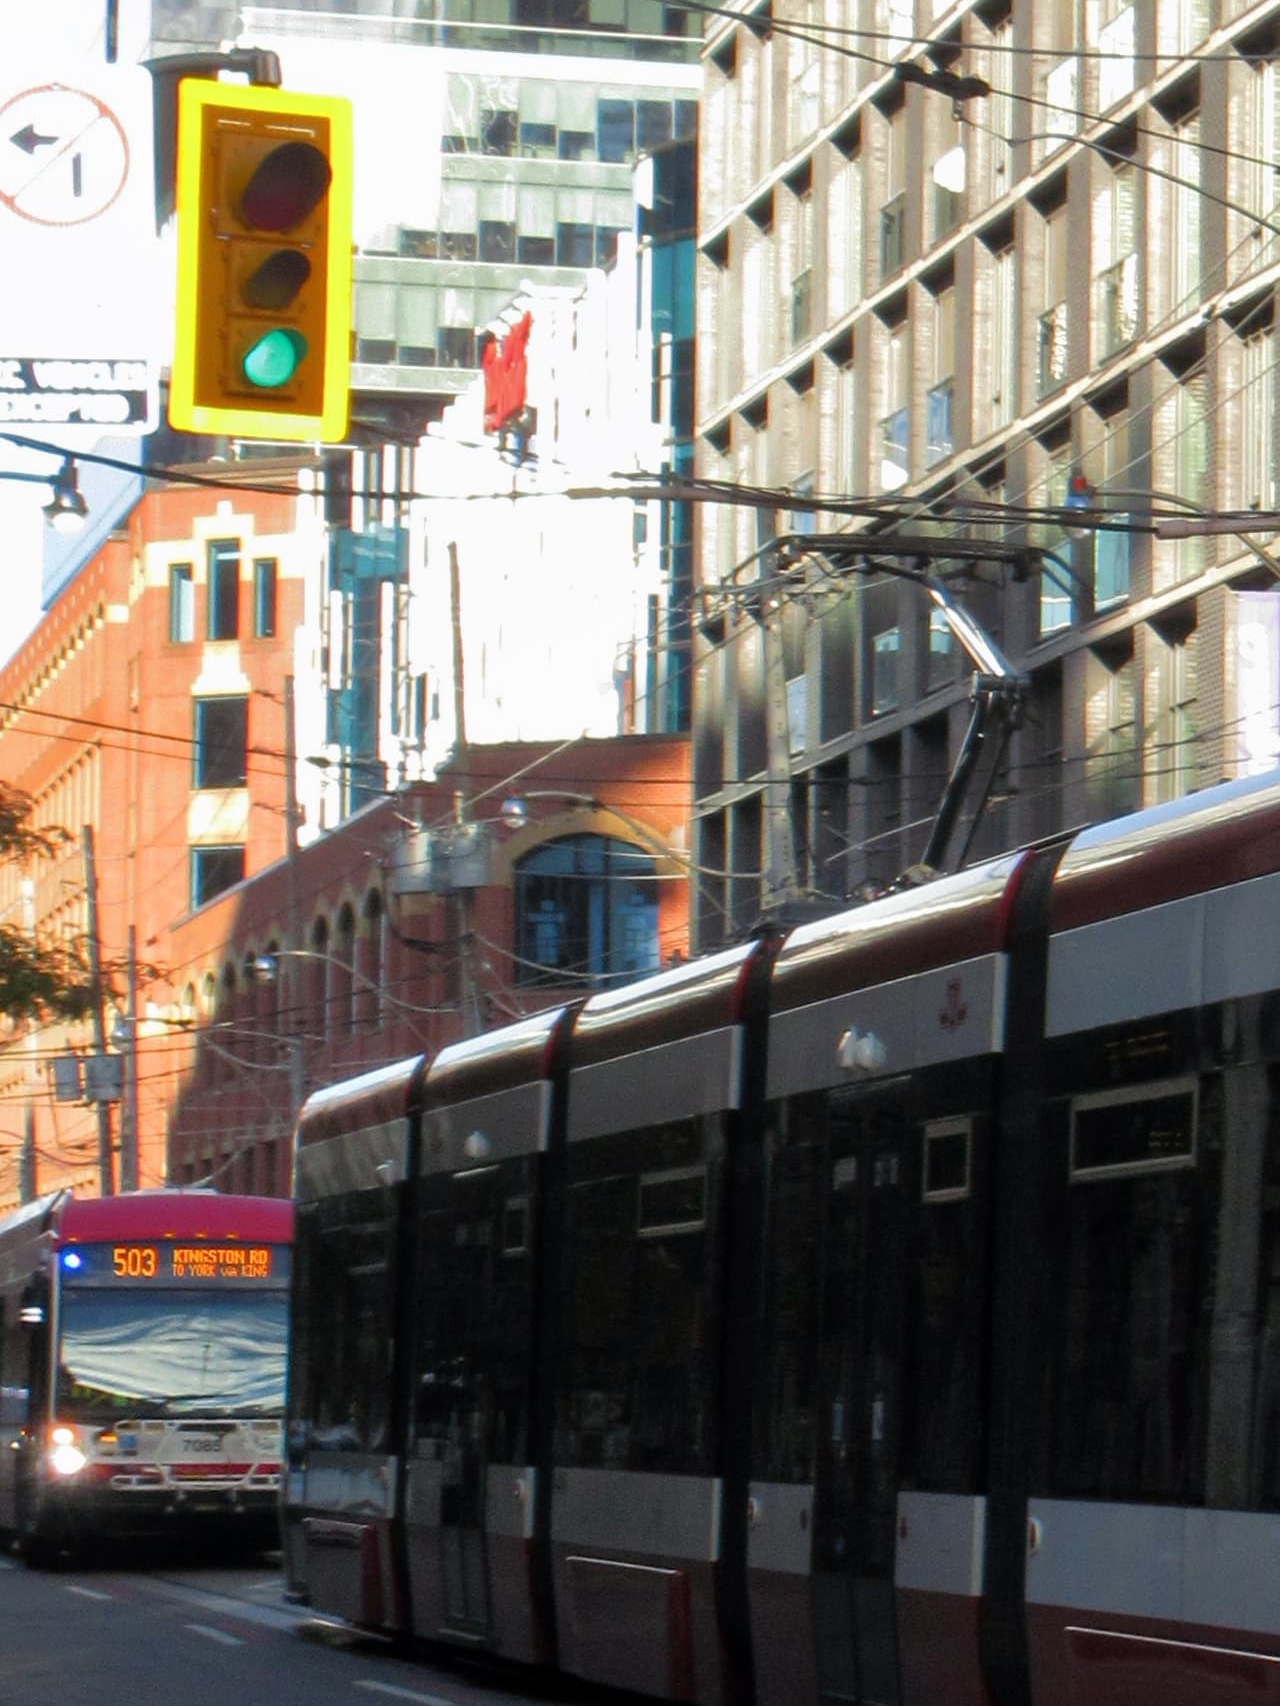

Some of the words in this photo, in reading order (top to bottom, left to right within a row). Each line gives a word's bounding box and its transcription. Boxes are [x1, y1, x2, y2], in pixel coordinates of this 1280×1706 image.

[113, 1248, 157, 1277] 503
[173, 1248, 245, 1264] KINGSTON
[249, 1248, 268, 1264] RD
[172, 1264, 184, 1277] TO
[241, 1264, 268, 1277] KING
